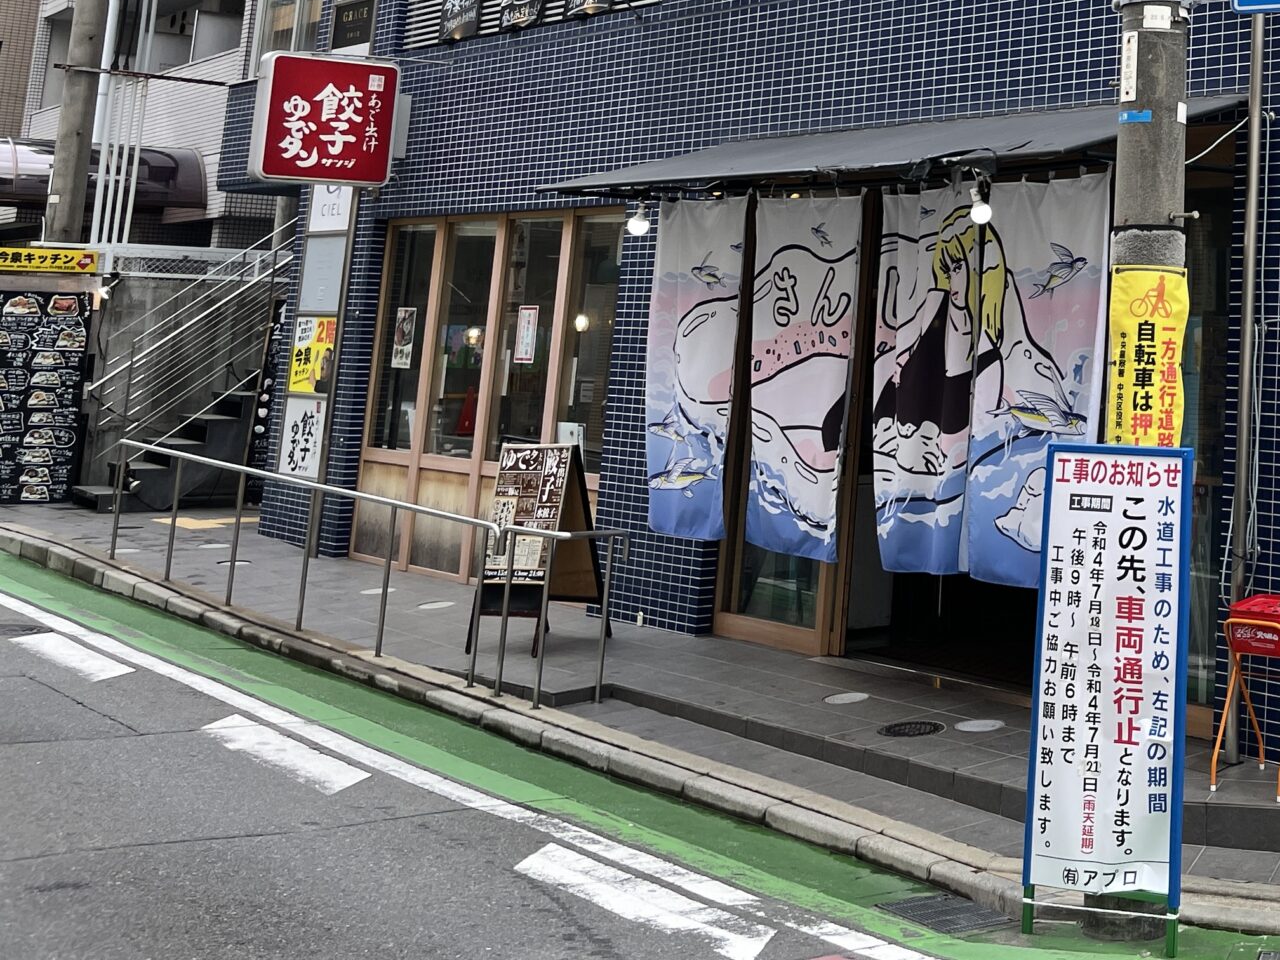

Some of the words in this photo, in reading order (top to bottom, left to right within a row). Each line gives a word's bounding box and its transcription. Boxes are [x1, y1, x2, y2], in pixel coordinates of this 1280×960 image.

[278, 95, 319, 168] ゆでタン
[313, 82, 364, 156] 餃子
[362, 93, 382, 154] あご出汁
[321, 158, 357, 169] サンジ
[321, 202, 342, 217] CIEL
[294, 346, 312, 367] 今泉
[316, 319, 337, 344] 2階
[1157, 326, 1177, 447] 一方通行道路
[300, 409, 315, 463] 餃子
[1055, 458, 1182, 488] 工事のお知らせ
[1071, 496, 1112, 511] 工事期間
[1112, 496, 1148, 856] この先、車両通行止となります。
[1147, 496, 1175, 814] 水道工事のため、左記の期間
[1038, 545, 1065, 849] 工事中ご協力お願い致します。
